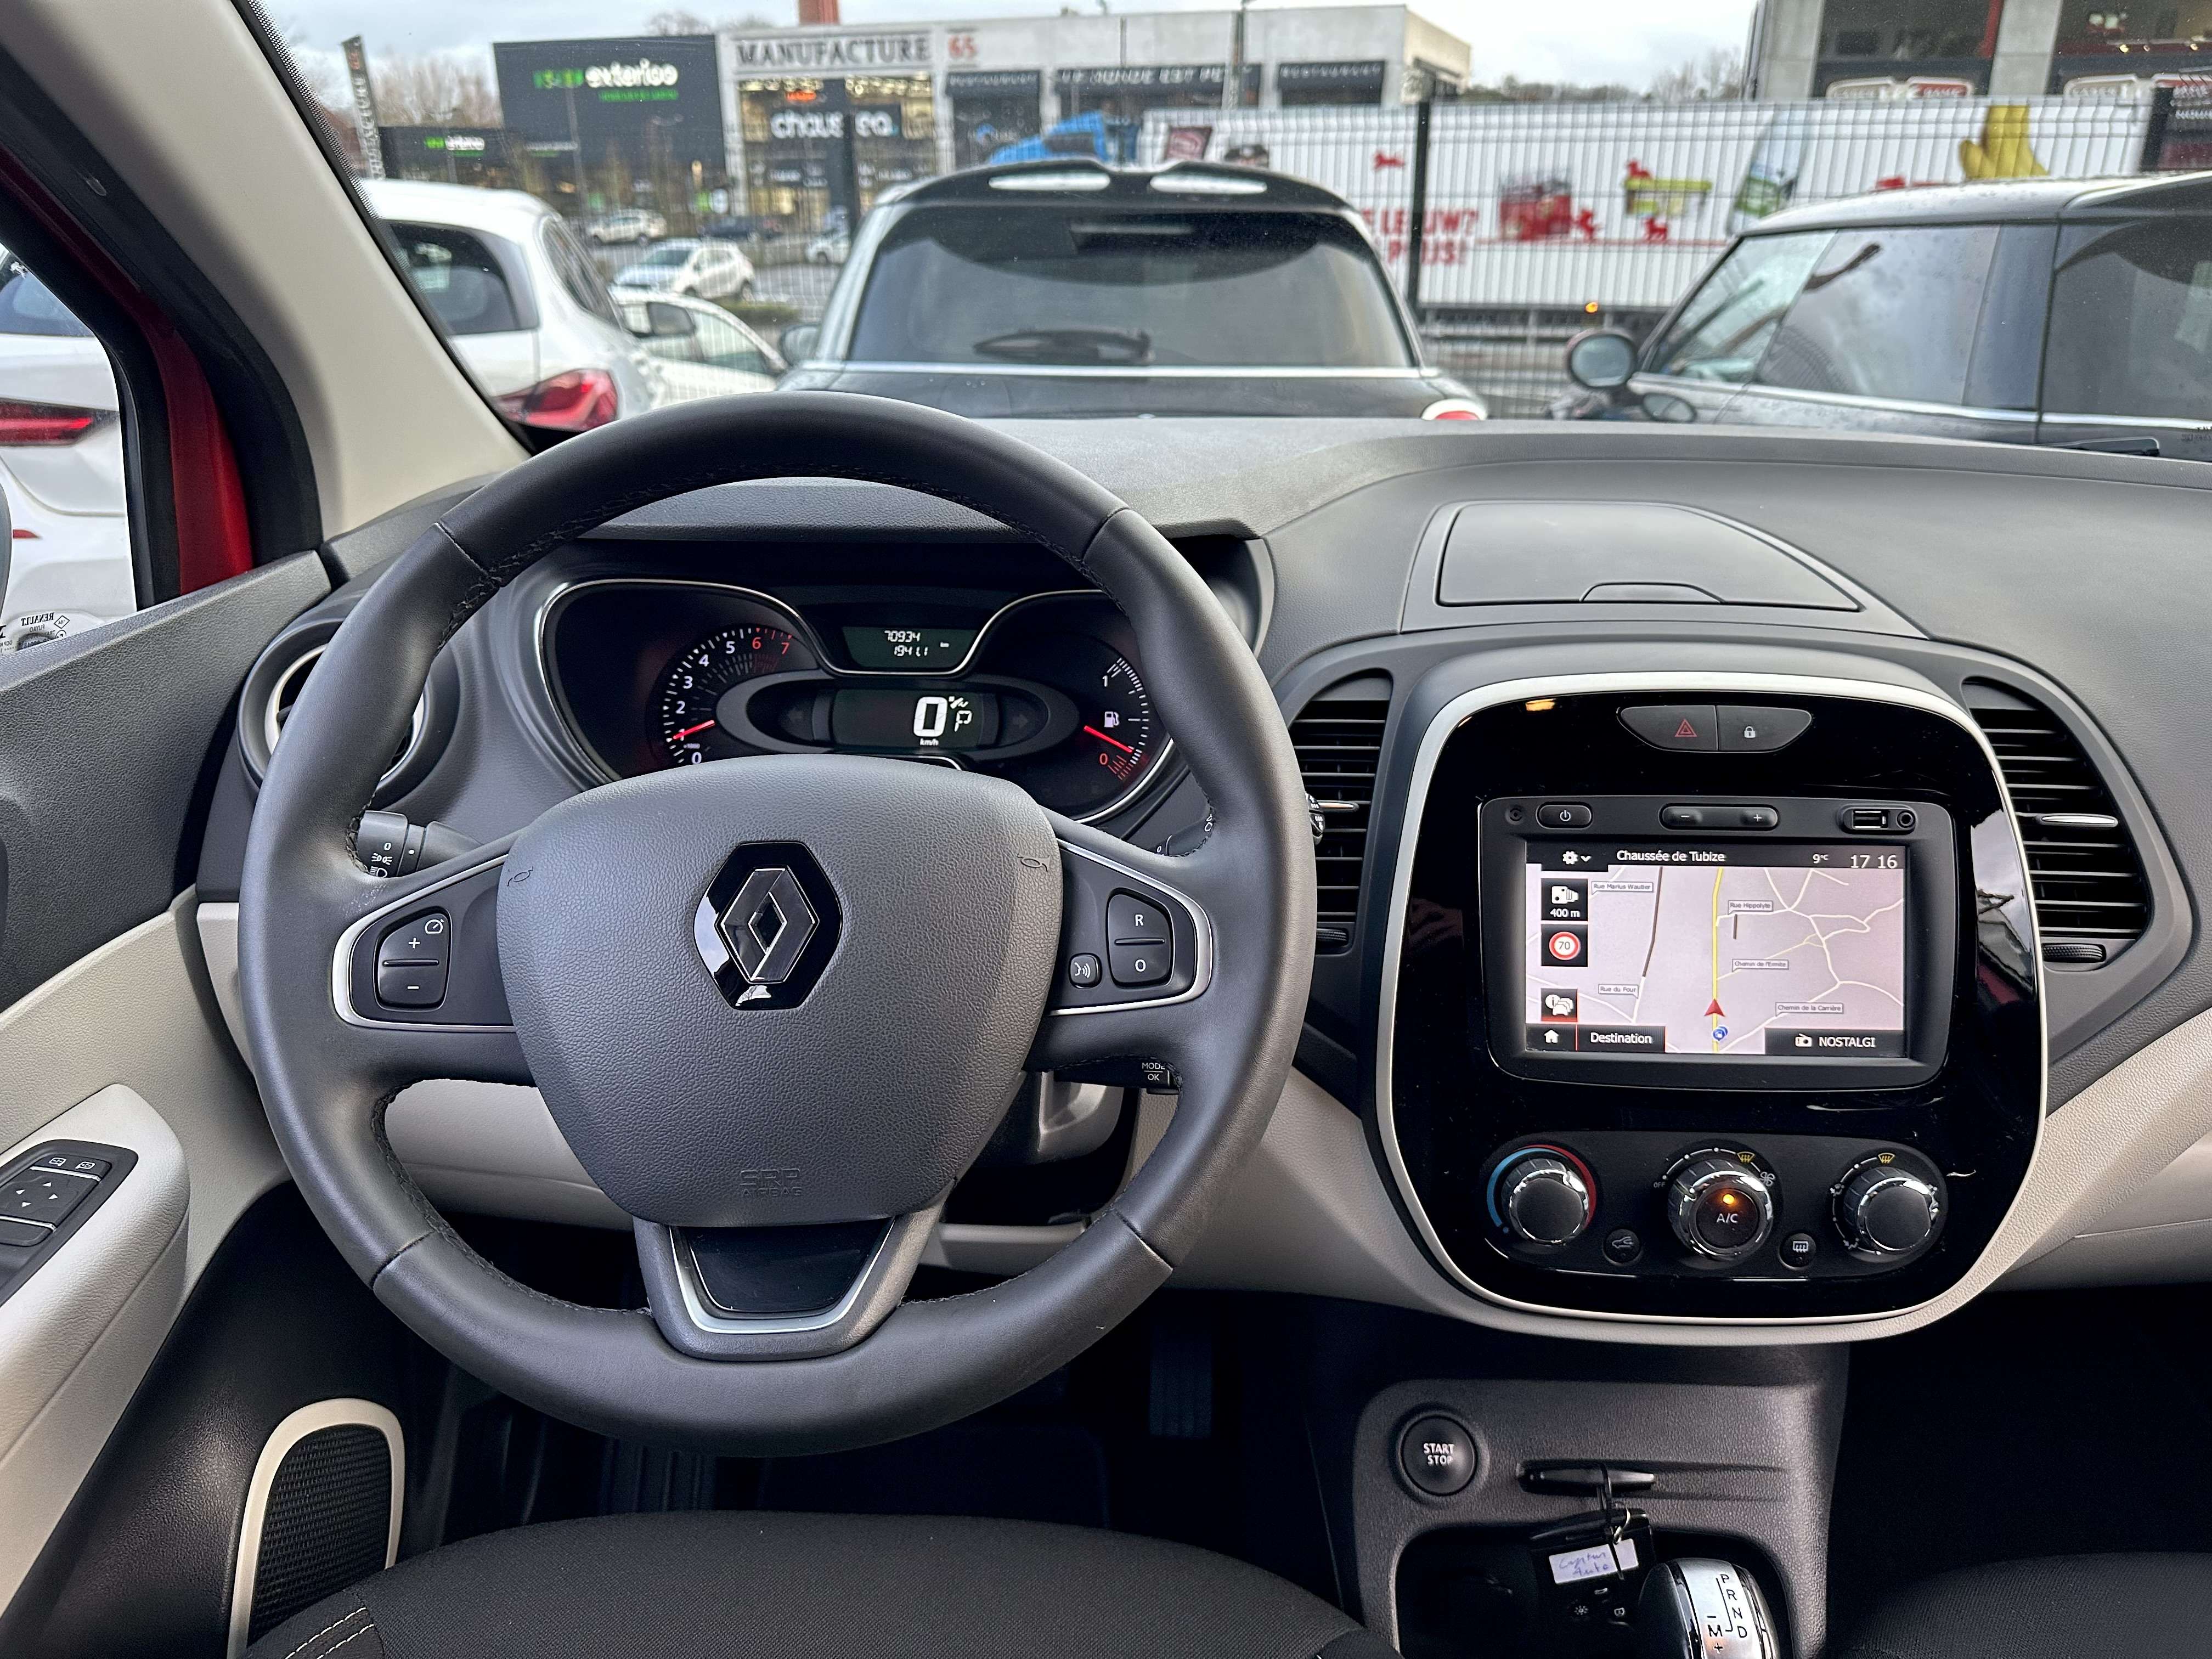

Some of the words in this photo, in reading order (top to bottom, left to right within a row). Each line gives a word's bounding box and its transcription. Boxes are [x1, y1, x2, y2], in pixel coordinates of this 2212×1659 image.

[770, 110, 893, 138] chausea
[884, 630, 921, 642] 70934
[725, 641, 736, 654] 5
[752, 636, 761, 650] 6
[781, 642, 791, 654] 7
[698, 654, 710, 667] 4
[682, 675, 693, 689] 3
[1102, 675, 1108, 687] 1
[675, 700, 686, 714] 2
[913, 696, 948, 737] 0
[954, 710, 973, 732] P
[919, 738, 939, 746] km/h
[691, 752, 702, 765] 0
[1099, 753, 1109, 765] 0
[1616, 850, 1669, 861] Chaussée
[1672, 851, 1686, 861] de
[1689, 851, 1726, 862] Tubize
[1850, 855, 1871, 869] 17
[1877, 855, 1898, 869] 16
[1550, 908, 1569, 917] 400
[1134, 914, 1144, 927] R
[1559, 941, 1571, 950] 70
[1590, 1032, 1653, 1044] Destination
[1819, 1036, 1876, 1048] NOSTALGI
[741, 1187, 802, 1198] AIRBAG
[1716, 1213, 1739, 1223] A/C
[1423, 1443, 1454, 1454] START
[1427, 1455, 1453, 1466] STOP
[1720, 1573, 1729, 1583] P
[1726, 1589, 1737, 1600] R
[1731, 1607, 1742, 1619] N
[1707, 1624, 1723, 1637] M
[1737, 1626, 1747, 1638] D
